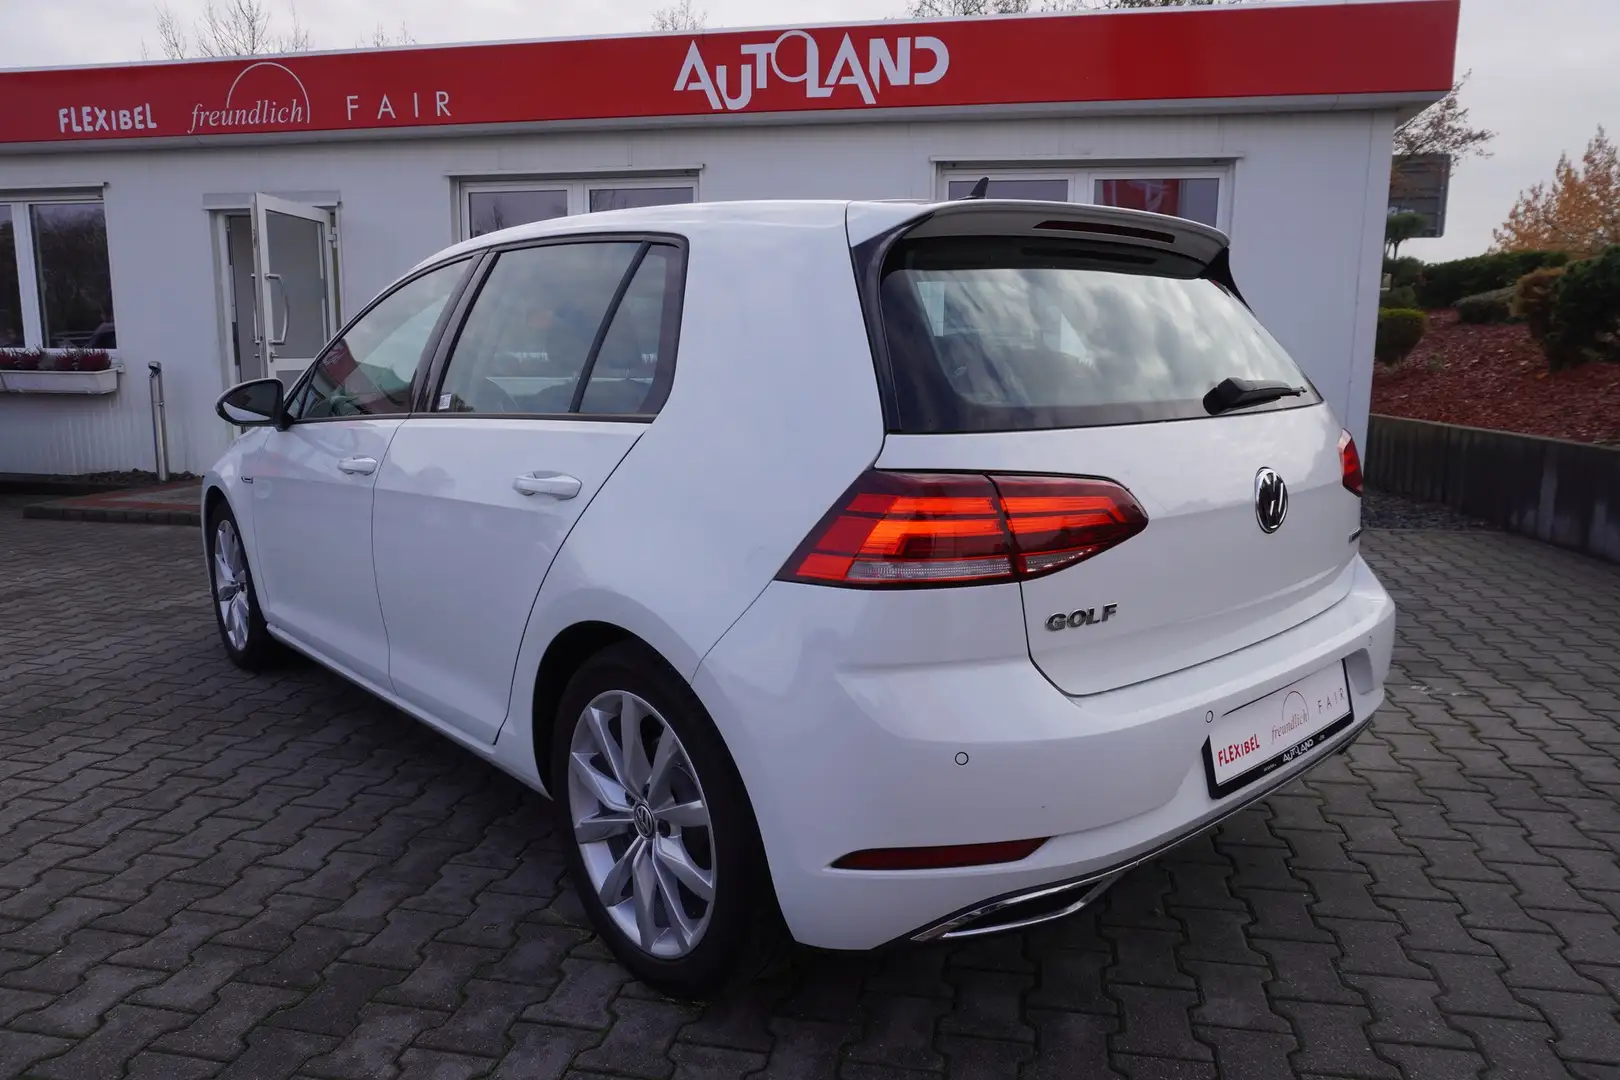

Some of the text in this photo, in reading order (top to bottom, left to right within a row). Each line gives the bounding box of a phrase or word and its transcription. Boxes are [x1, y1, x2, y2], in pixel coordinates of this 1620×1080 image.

[58, 90, 452, 134] FLEXIBEL freundlich FAIR
[1045, 603, 1118, 632] GOLF
[1218, 687, 1346, 766] FLEXIBEL freundlich FAIR
